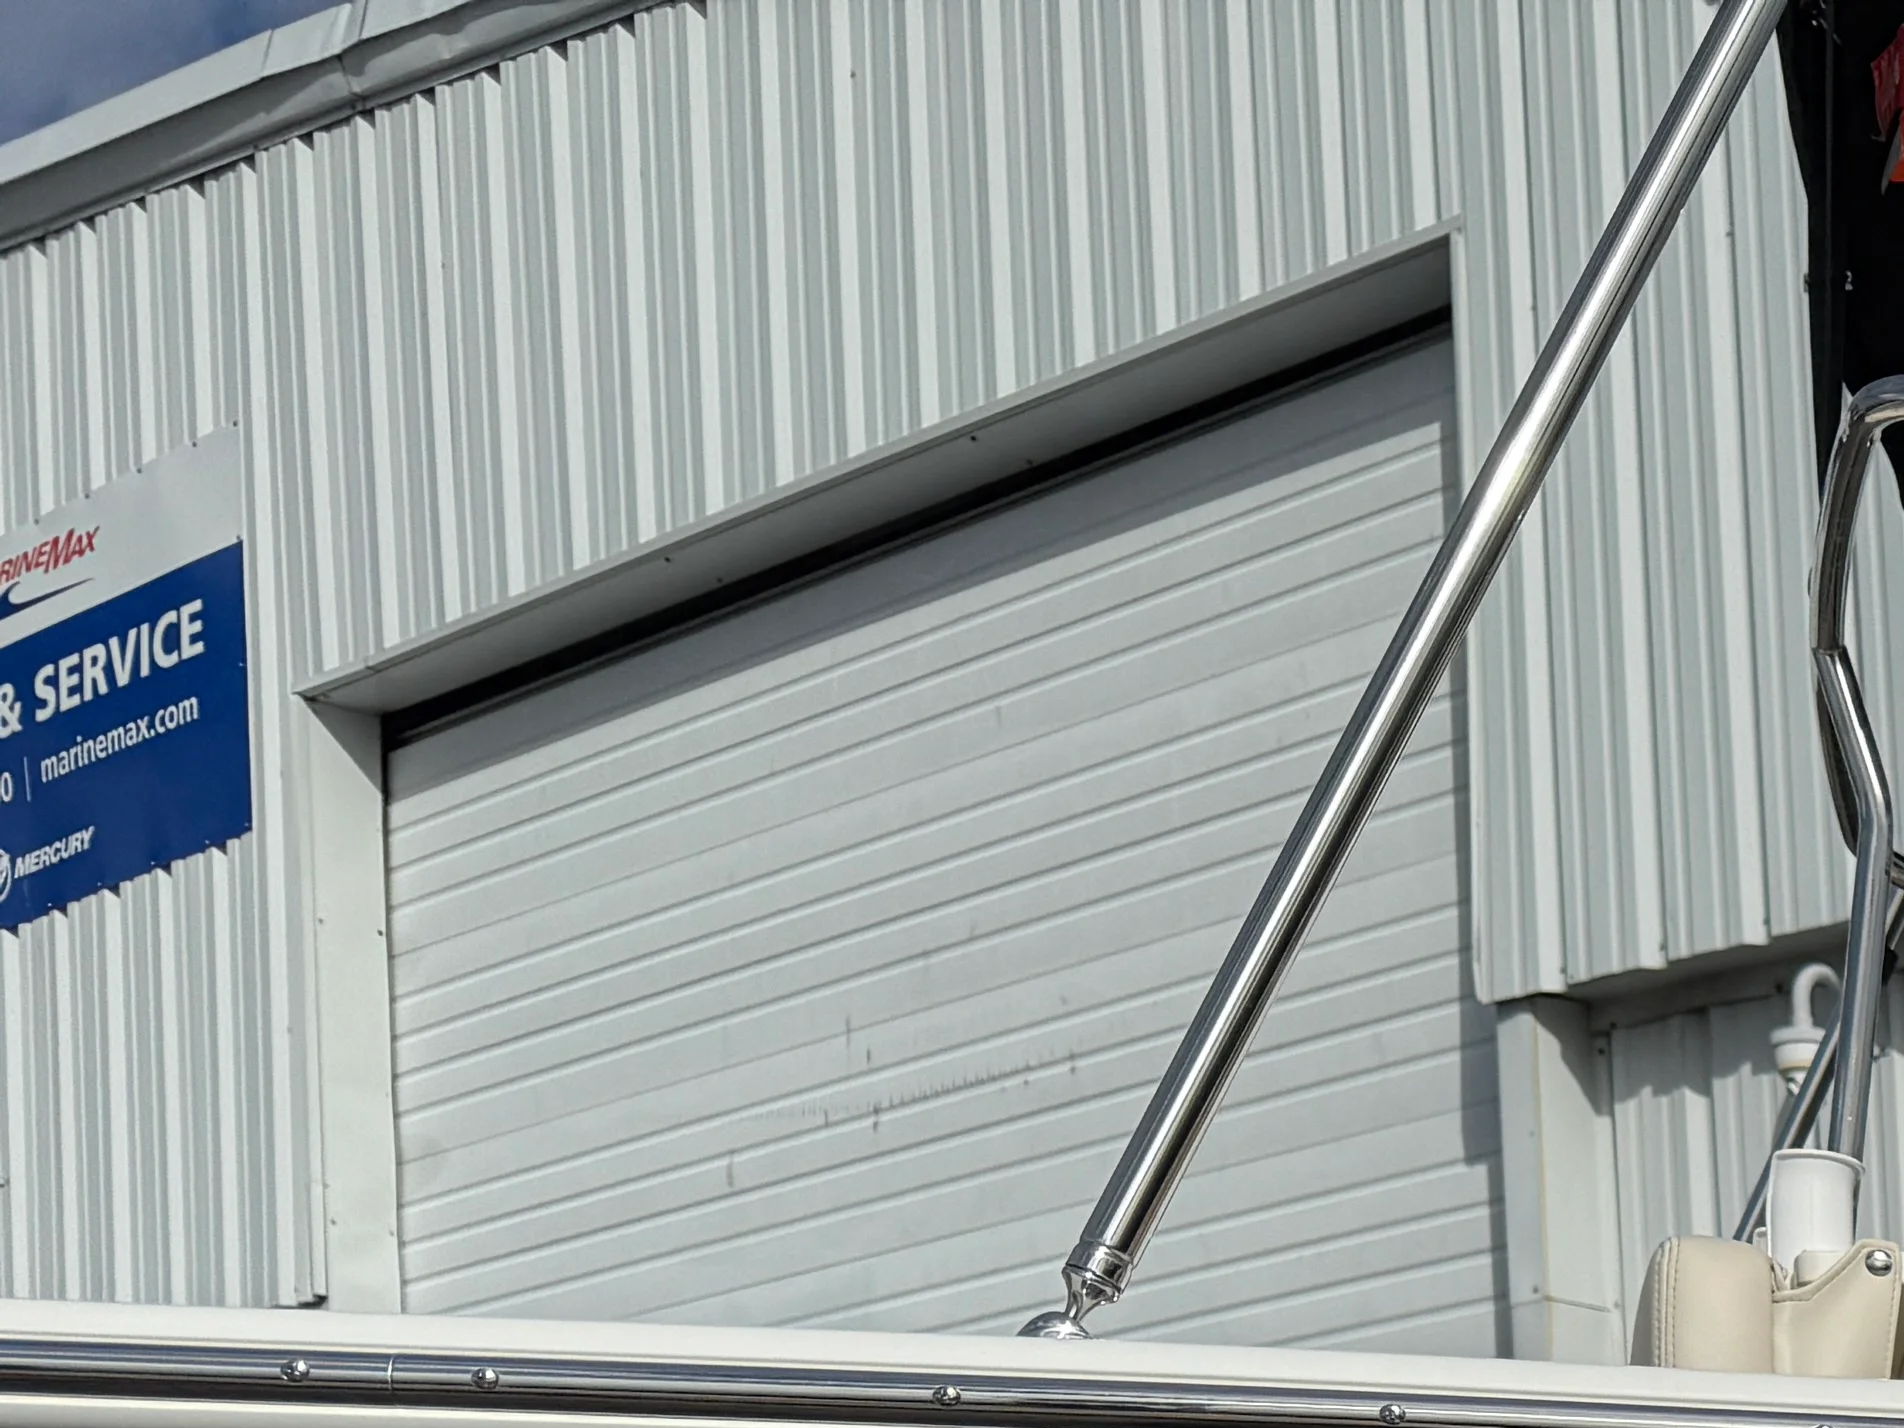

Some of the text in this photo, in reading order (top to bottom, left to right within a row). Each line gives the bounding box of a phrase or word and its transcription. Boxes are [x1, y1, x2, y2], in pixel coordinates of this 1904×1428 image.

[34, 599, 205, 722] SERVICE
[40, 697, 199, 783] marinemax.com
[14, 825, 95, 878] MERCURY
